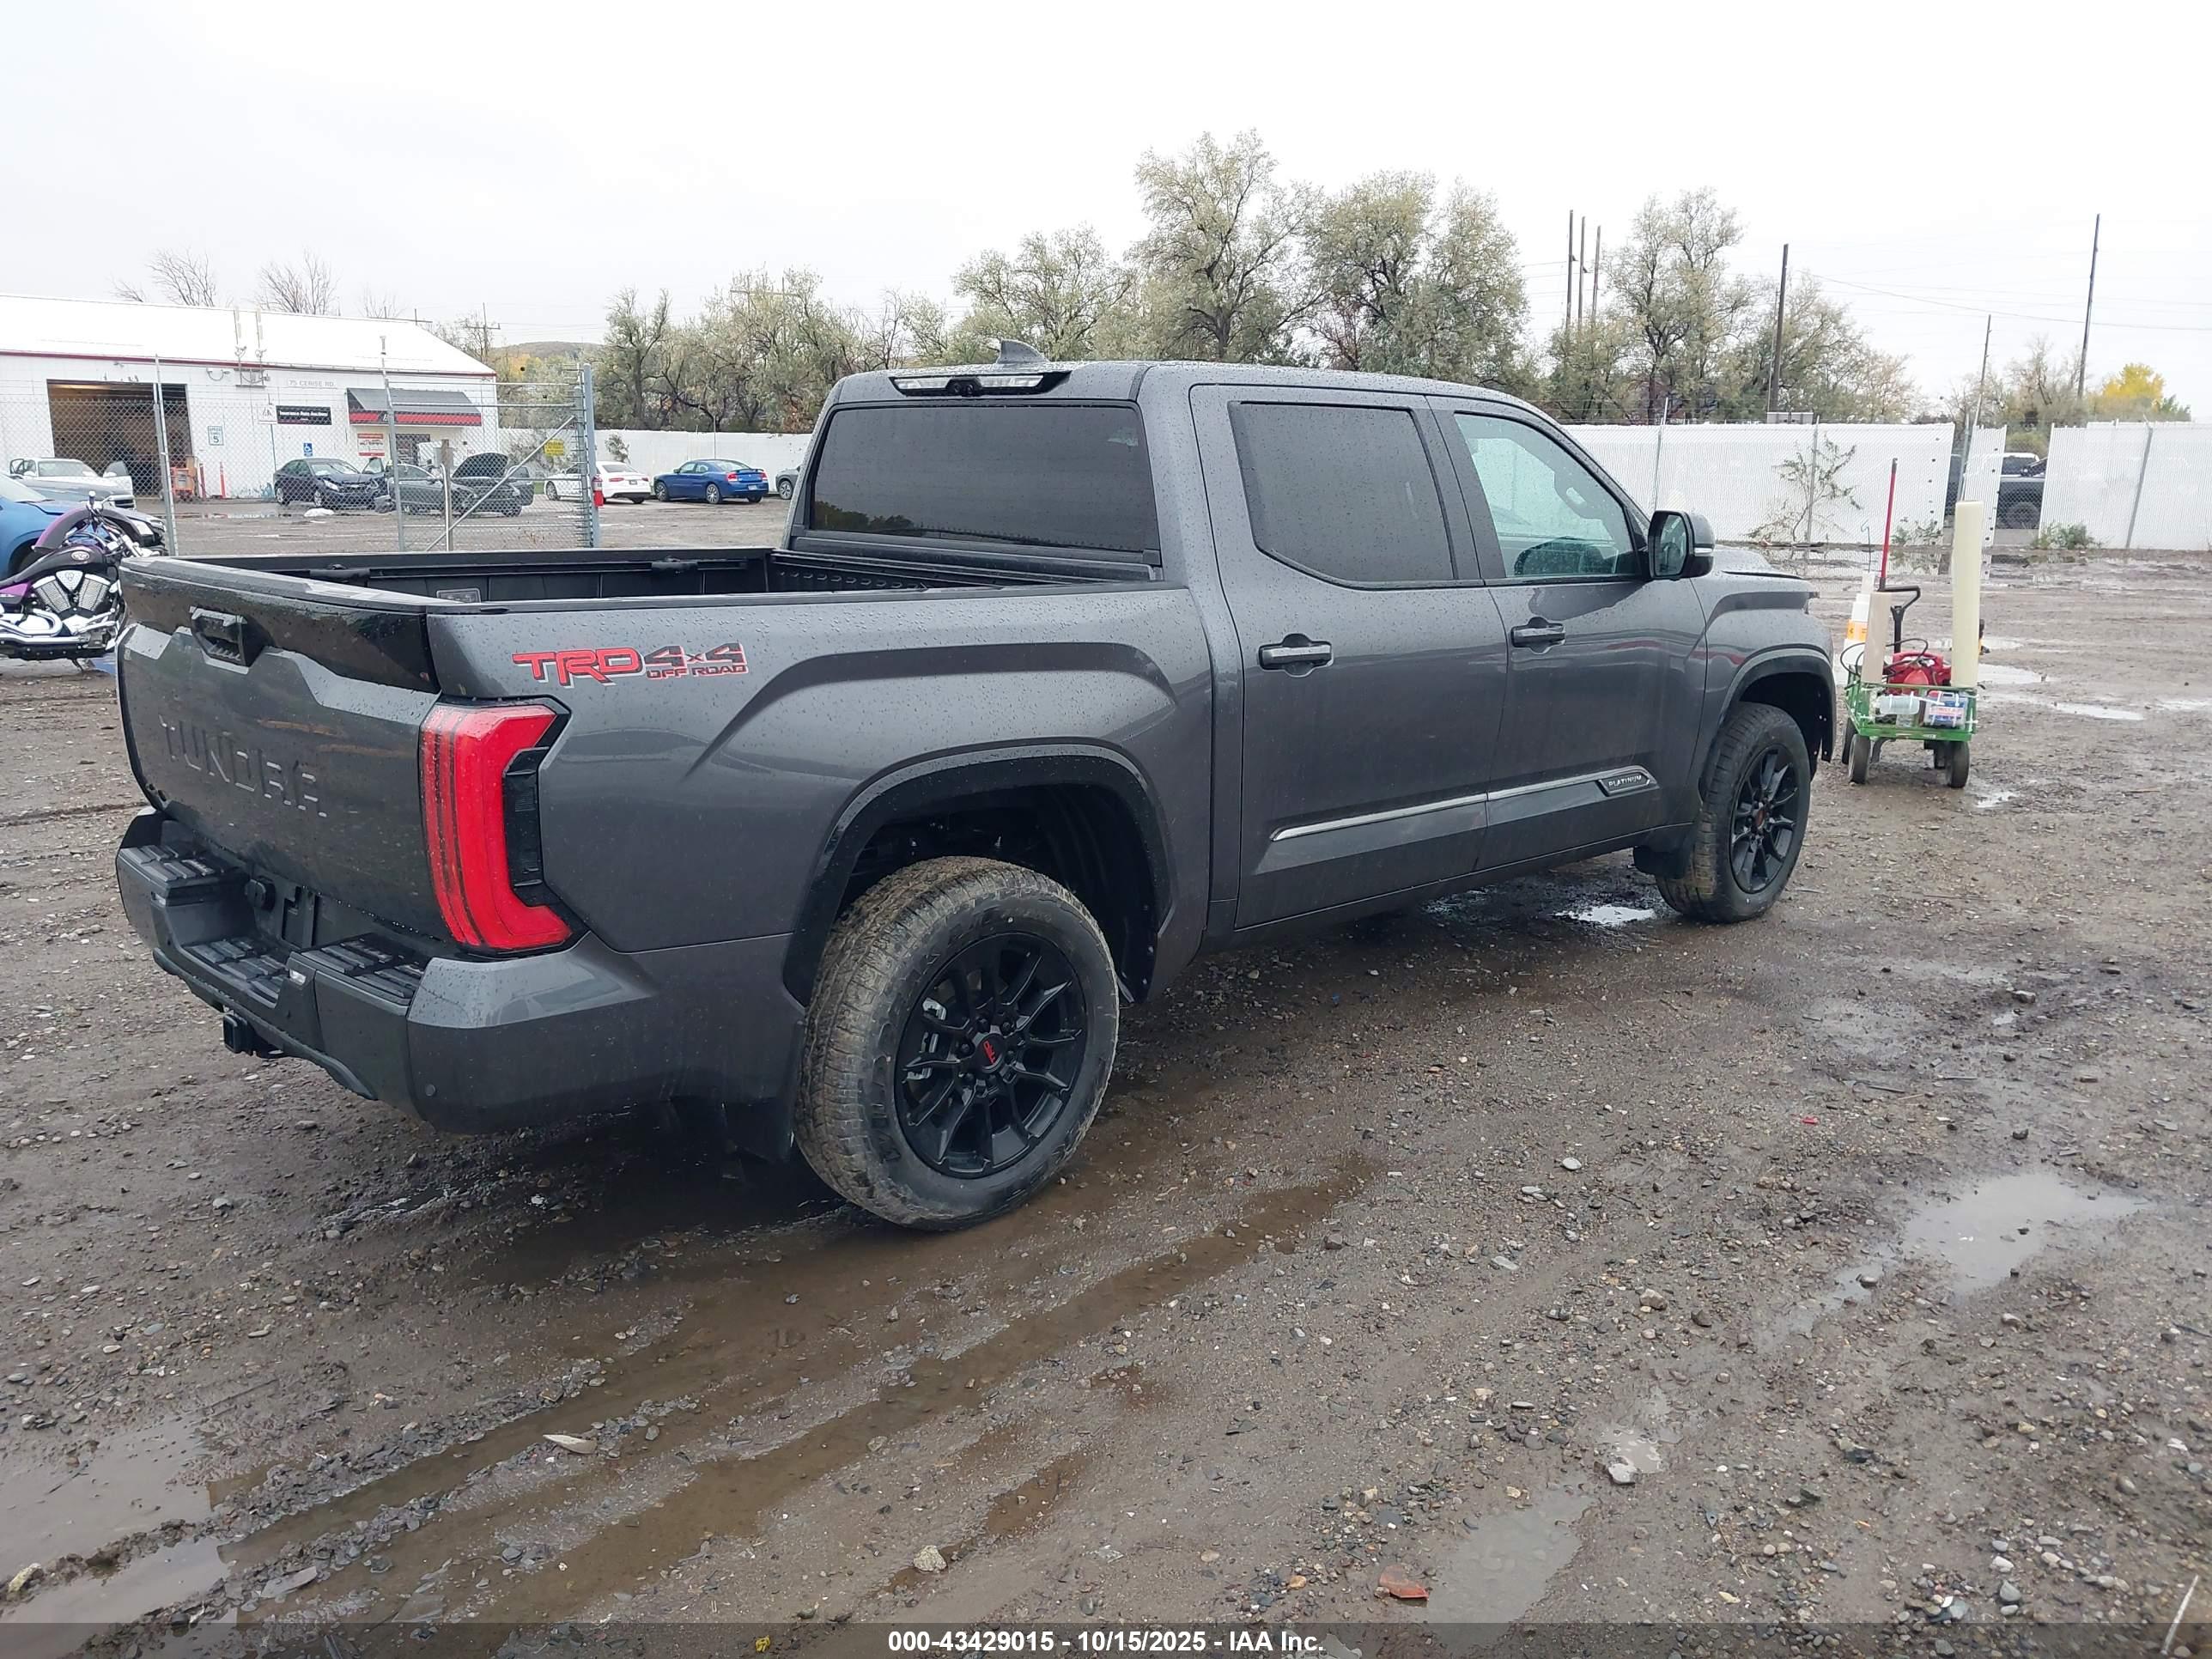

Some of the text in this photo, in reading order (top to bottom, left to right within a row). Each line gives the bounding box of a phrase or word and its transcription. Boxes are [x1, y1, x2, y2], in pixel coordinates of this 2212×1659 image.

[513, 641, 748, 689] TRD 4x4
[646, 663, 750, 679] OFF ROAD
[158, 714, 328, 818] TUNDRA
[1608, 775, 1642, 787] PLATINUM
